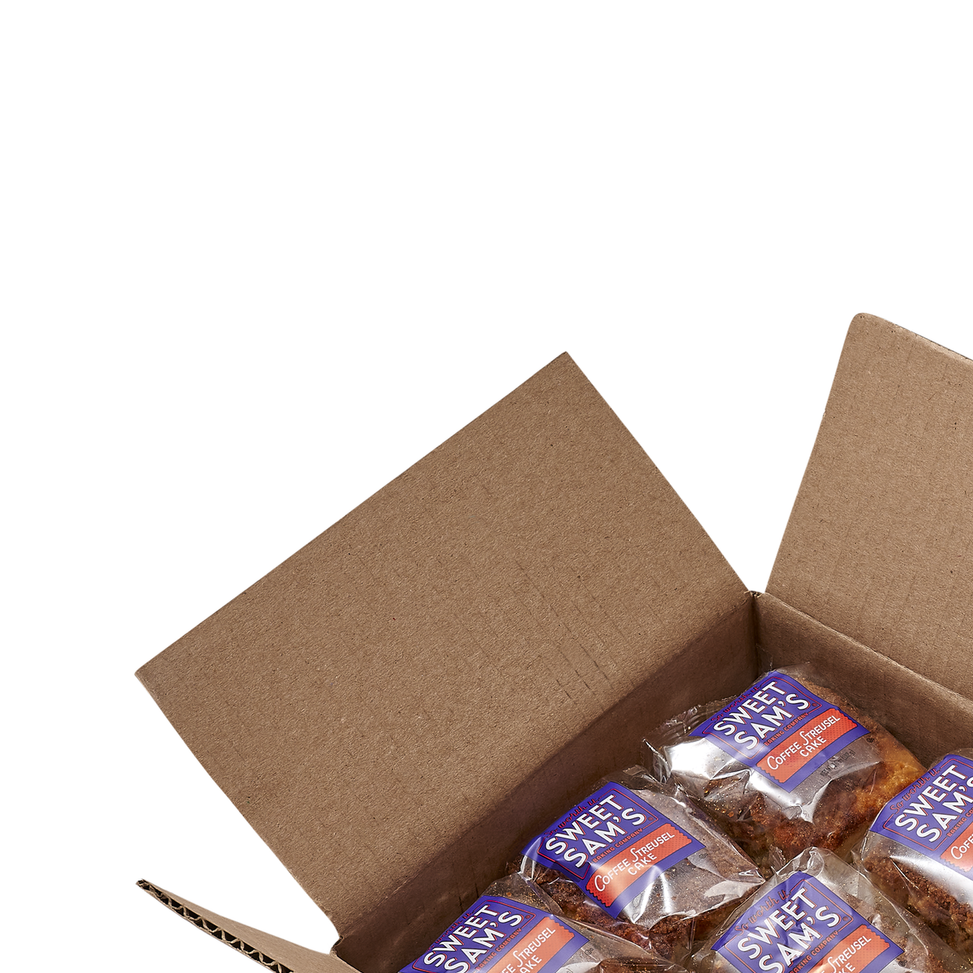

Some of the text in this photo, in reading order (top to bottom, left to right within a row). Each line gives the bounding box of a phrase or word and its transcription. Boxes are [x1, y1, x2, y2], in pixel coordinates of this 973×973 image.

[714, 681, 786, 736] SWEET
[734, 694, 809, 750] SAM'S
[767, 742, 802, 770] COFFEE
[800, 715, 840, 745] STREUSEL
[800, 737, 827, 757] CAKE
[545, 794, 624, 855] SWEET
[895, 765, 966, 831] SWEET
[564, 808, 645, 868] SAM'S
[594, 832, 675, 892] COFFEE STREUSEL
[628, 852, 657, 875] CAKE
[423, 905, 497, 967] SWEET
[513, 927, 555, 967] STREUSEL
[737, 888, 815, 959] SWEET
